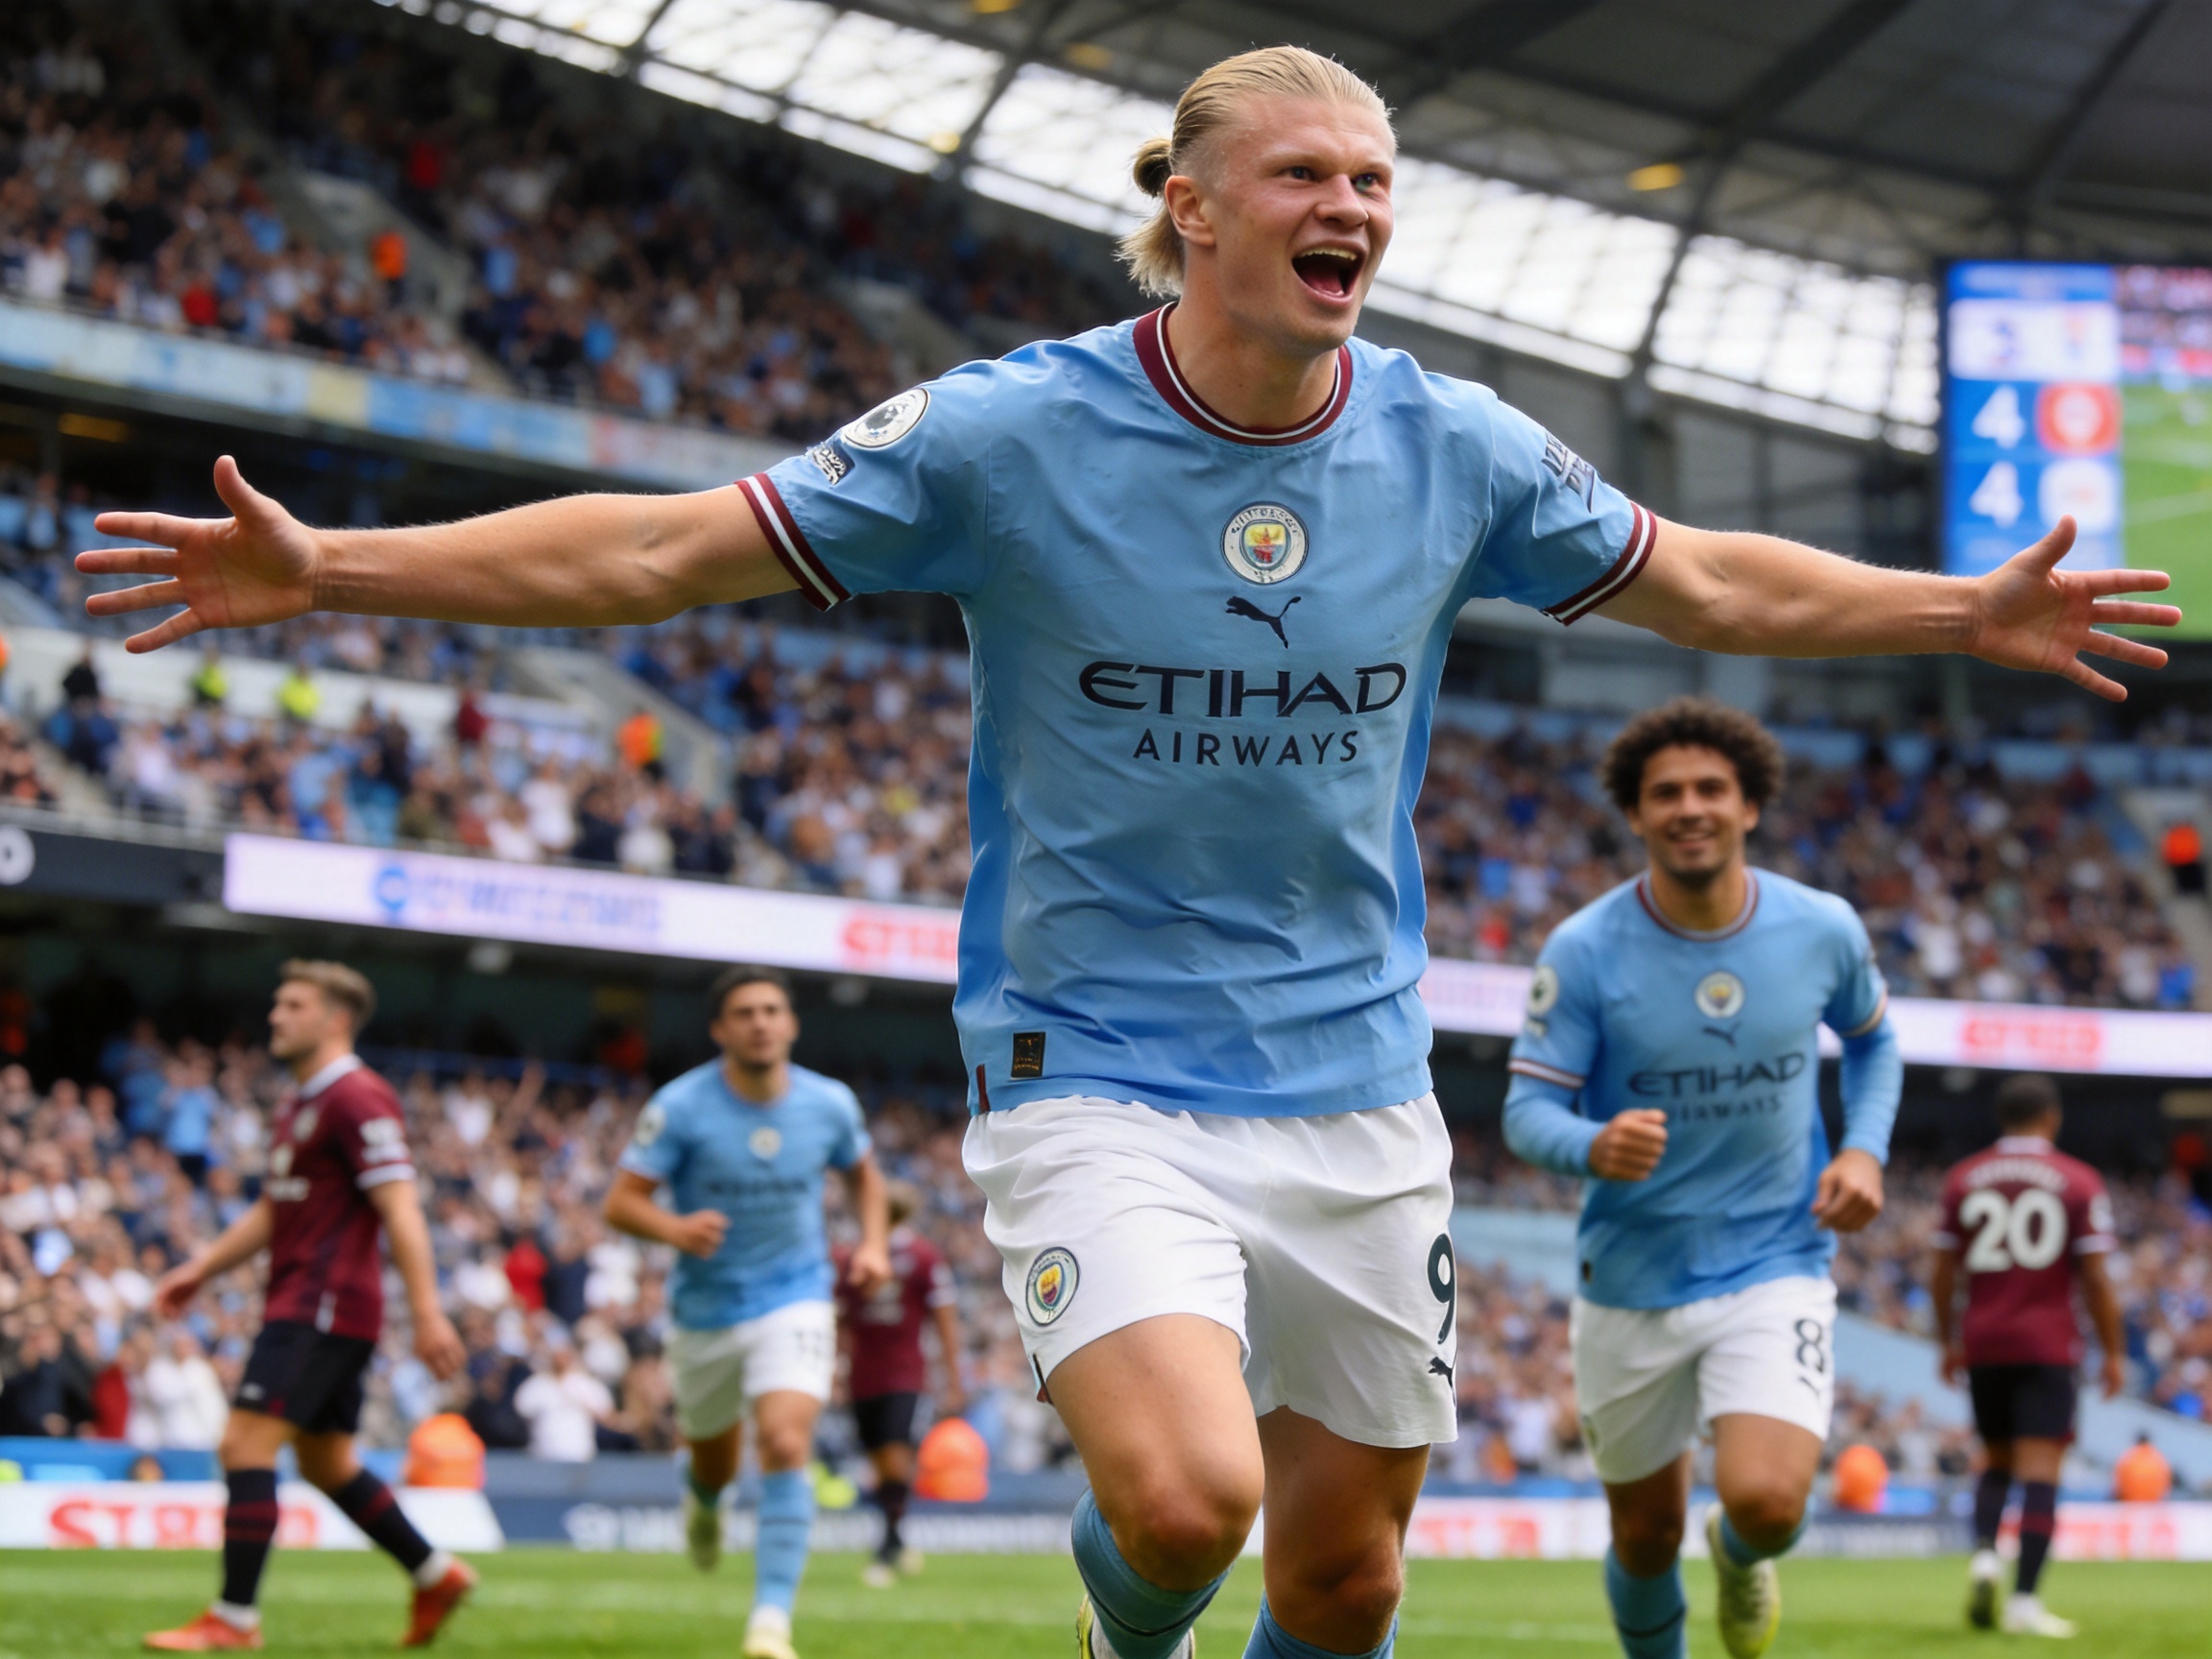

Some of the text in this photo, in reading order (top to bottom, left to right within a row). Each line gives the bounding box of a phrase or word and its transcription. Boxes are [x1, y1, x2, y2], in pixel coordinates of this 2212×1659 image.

[1972, 386, 2026, 447] 4
[1970, 461, 2024, 526] 4
[1079, 661, 1407, 717] ETIHAD
[1133, 728, 1357, 766] AIRWAYS
[1627, 1052, 1805, 1097] ETIHAD
[1959, 1188, 2068, 1274] 20
[1428, 1233, 1455, 1345] 9
[1793, 1317, 1825, 1374] 8
